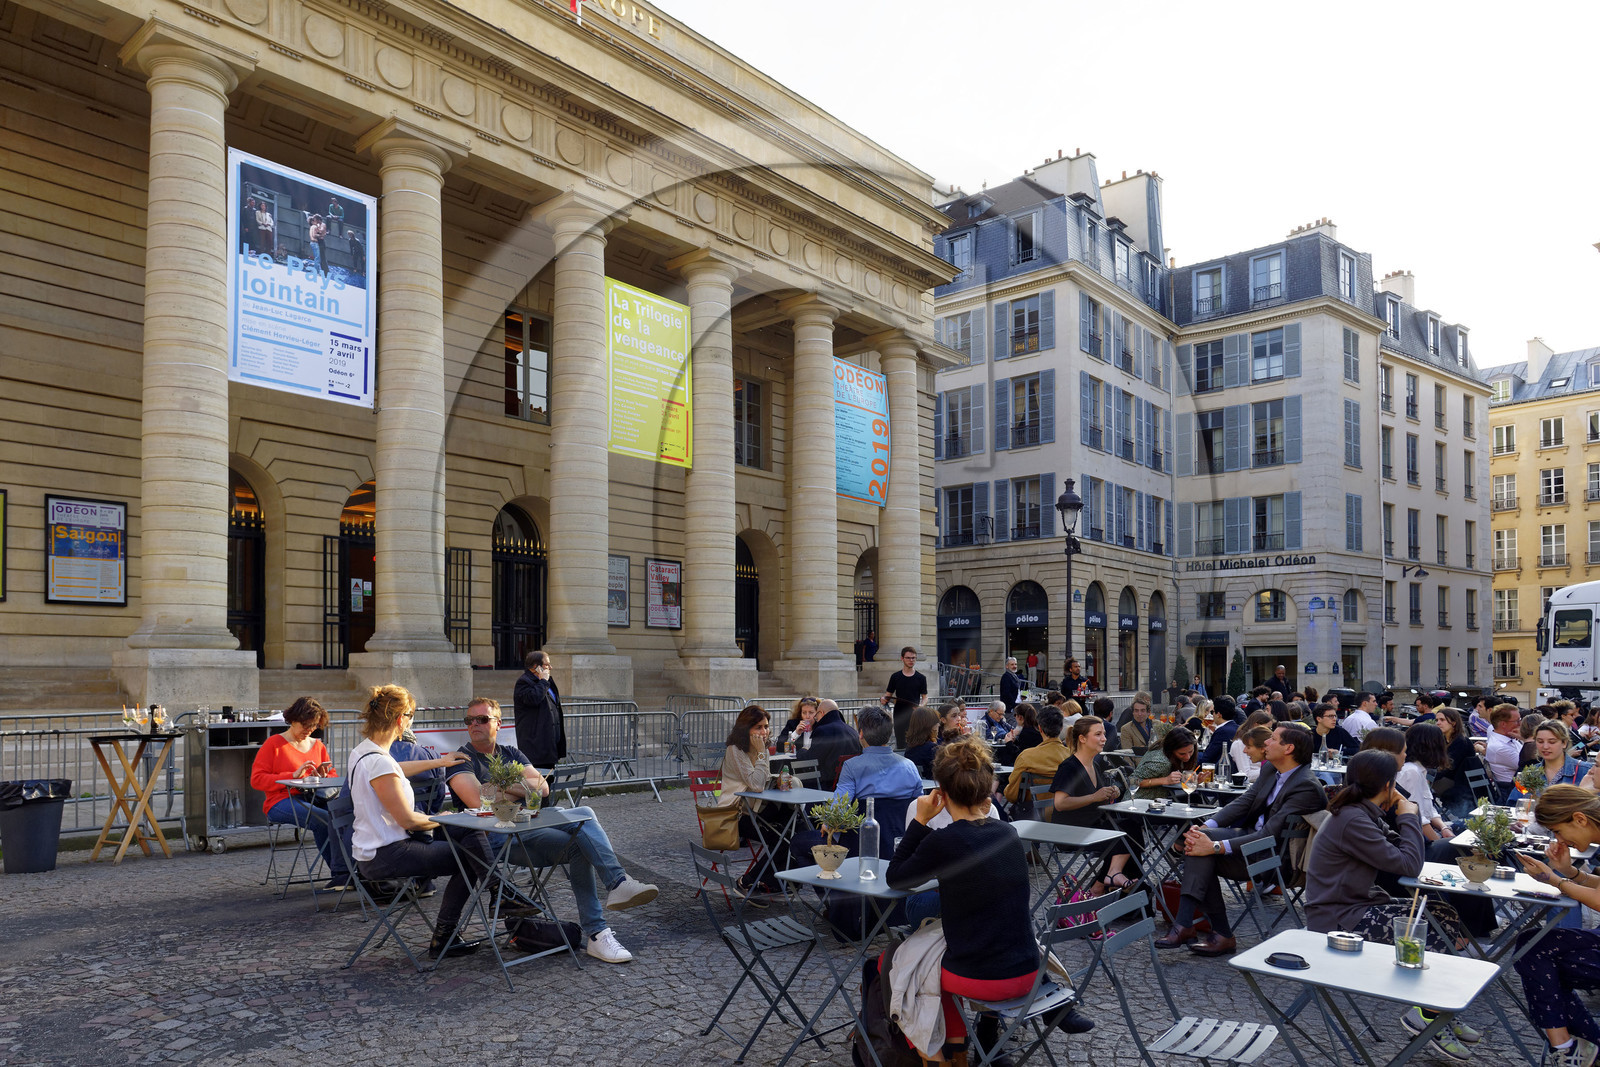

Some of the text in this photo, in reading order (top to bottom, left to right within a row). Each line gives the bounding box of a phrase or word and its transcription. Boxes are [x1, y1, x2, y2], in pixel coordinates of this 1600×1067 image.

[242, 242, 346, 291] Le Pays
[242, 270, 340, 315] lointain
[251, 302, 284, 316] Jean-Luc
[613, 292, 682, 330] La Trilogie
[241, 323, 272, 336] Clément
[613, 312, 651, 336] de la
[329, 347, 355, 360] 7 avril
[330, 338, 362, 353] 15 mars
[614, 331, 685, 364] vengeance
[328, 357, 347, 368] 2019
[328, 367, 348, 377] Odéon
[834, 364, 884, 395] ODÉON
[836, 390, 877, 409] DE L'EUROPE
[868, 418, 889, 502] 2019
[55, 504, 97, 516] ODÉON
[55, 525, 118, 544] Saigon
[650, 564, 678, 575] Cataract
[1186, 554, 1316, 572] Hôtel Michelet Odéon
[650, 573, 670, 583] Valley
